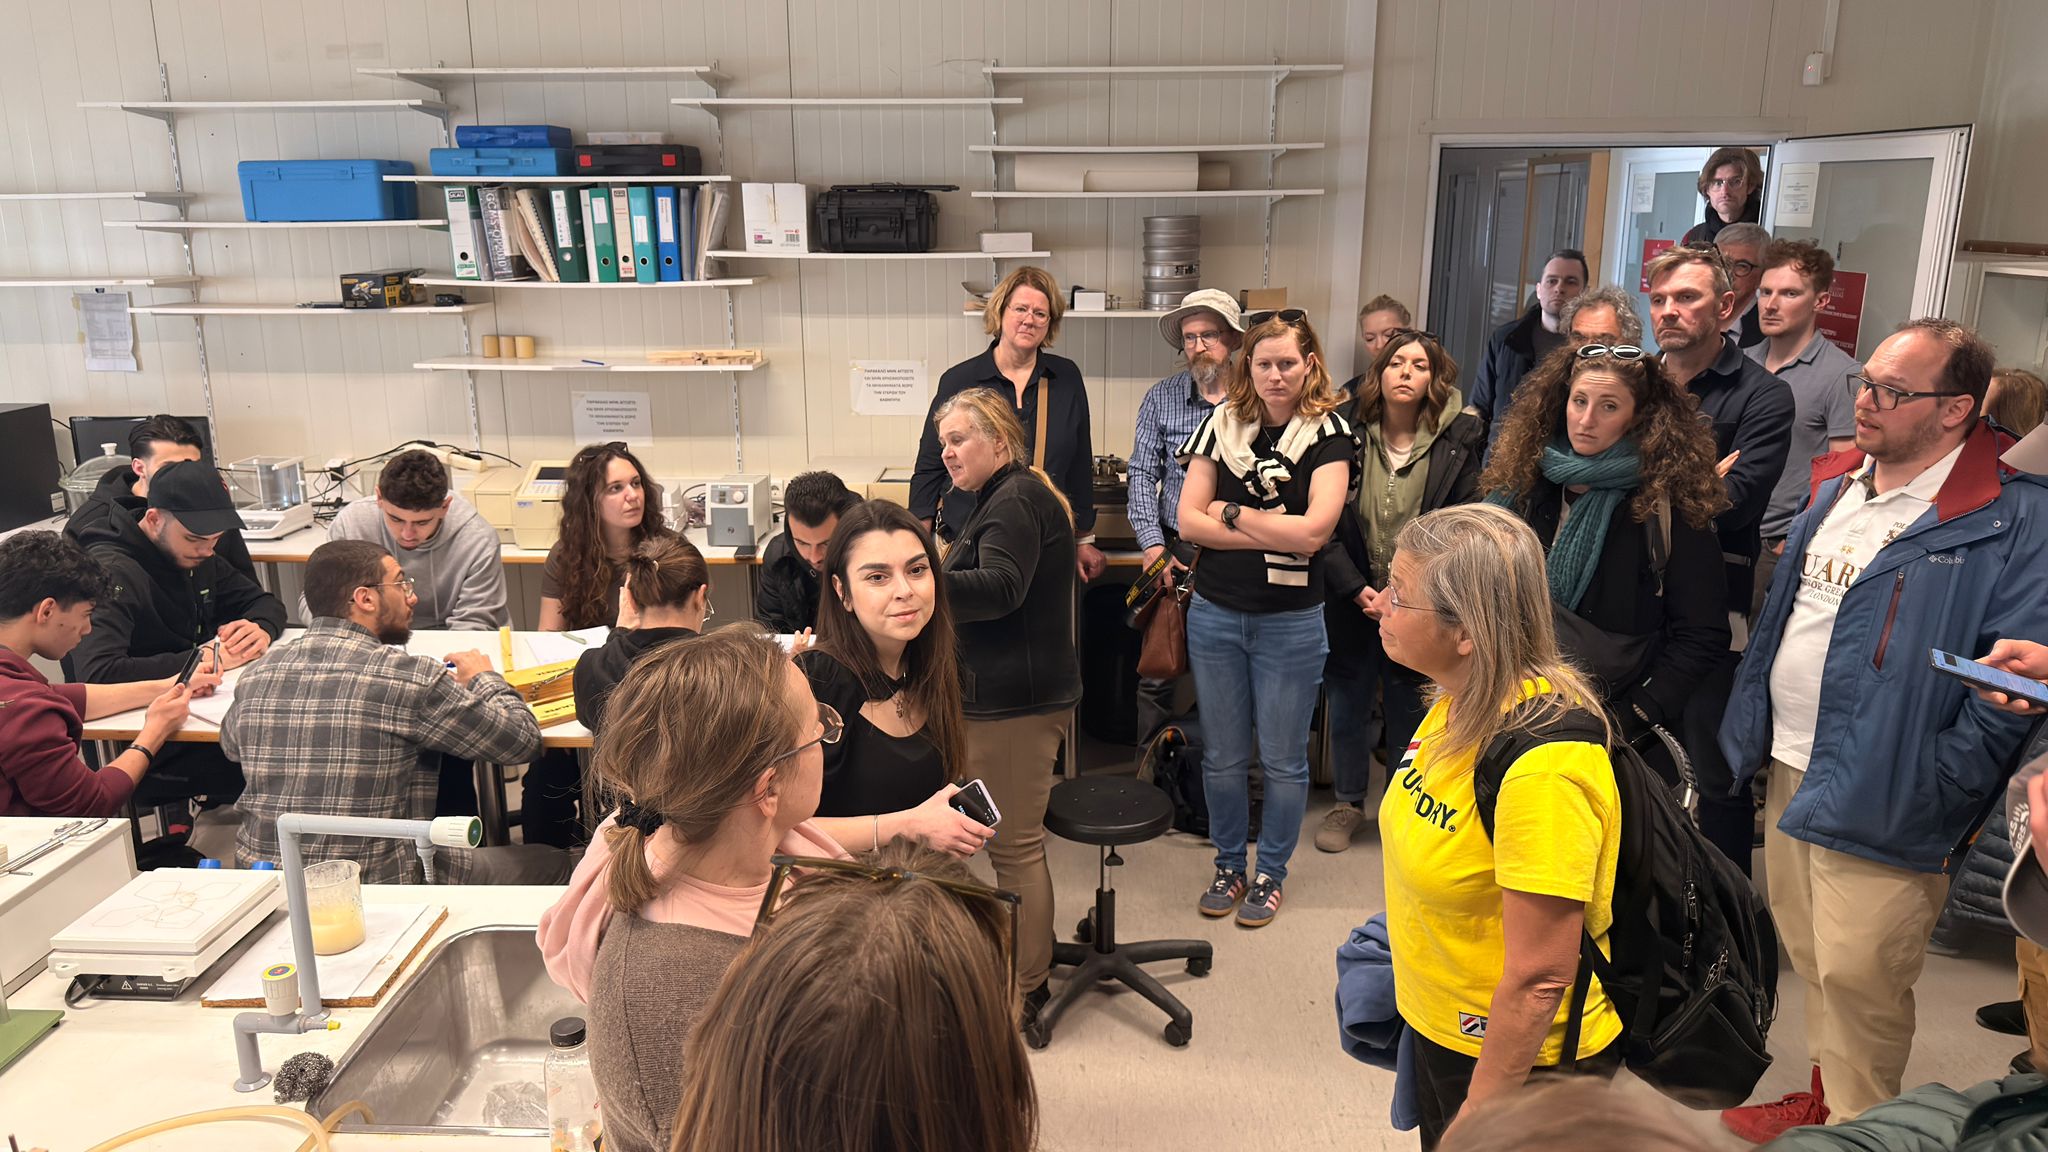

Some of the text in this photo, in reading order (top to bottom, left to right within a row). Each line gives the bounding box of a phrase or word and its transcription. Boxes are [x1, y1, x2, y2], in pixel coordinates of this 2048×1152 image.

[1147, 557, 1166, 577] Nikon
[1801, 552, 1864, 588] UAR
[1809, 589, 1839, 606] LONDON
